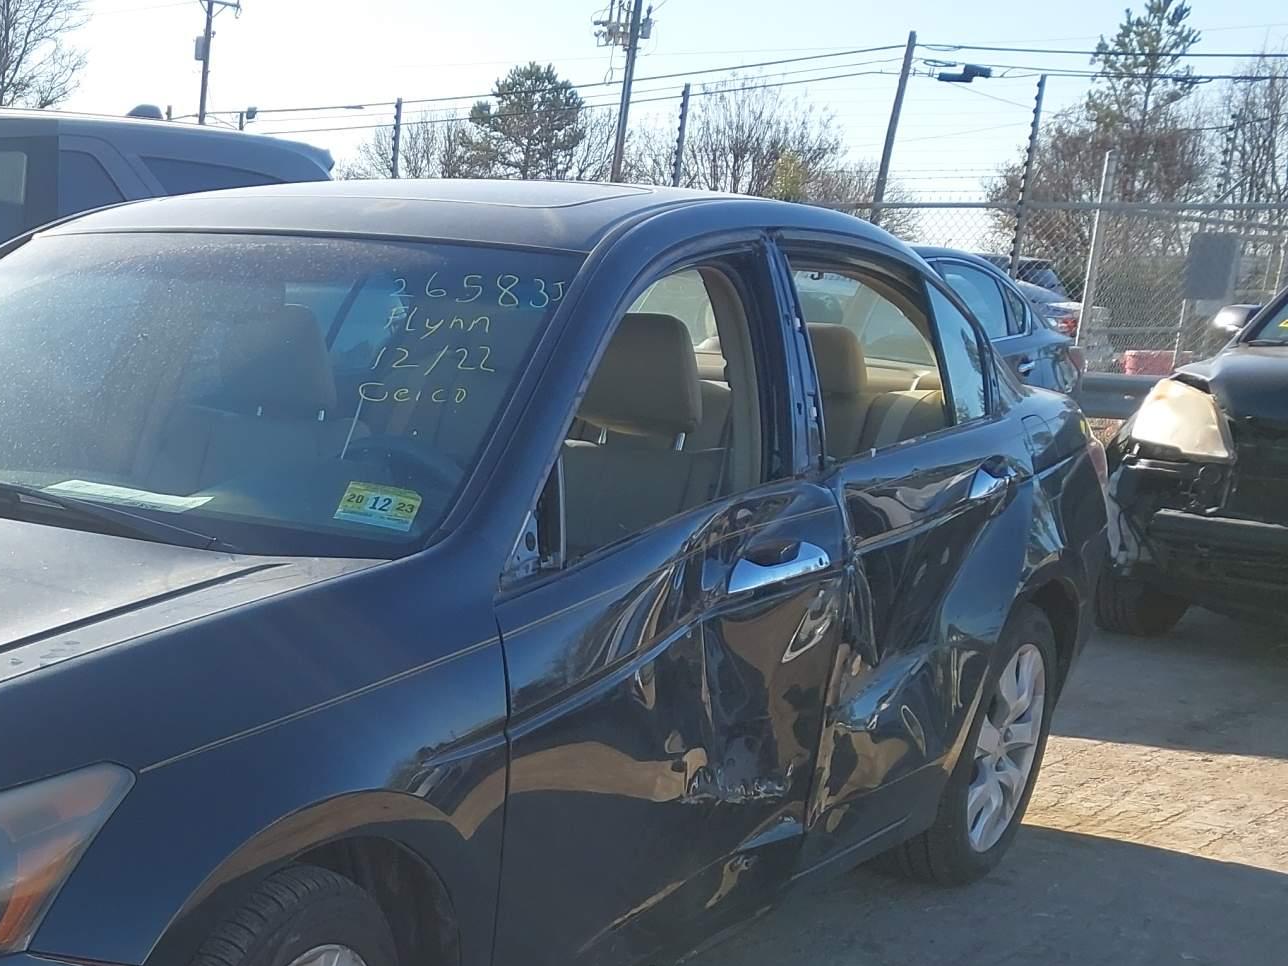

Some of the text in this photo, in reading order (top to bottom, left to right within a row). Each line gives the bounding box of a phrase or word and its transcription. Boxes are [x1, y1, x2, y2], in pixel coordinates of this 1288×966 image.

[370, 345, 495, 376] 12/22
[346, 493, 415, 514] 20 12 23
